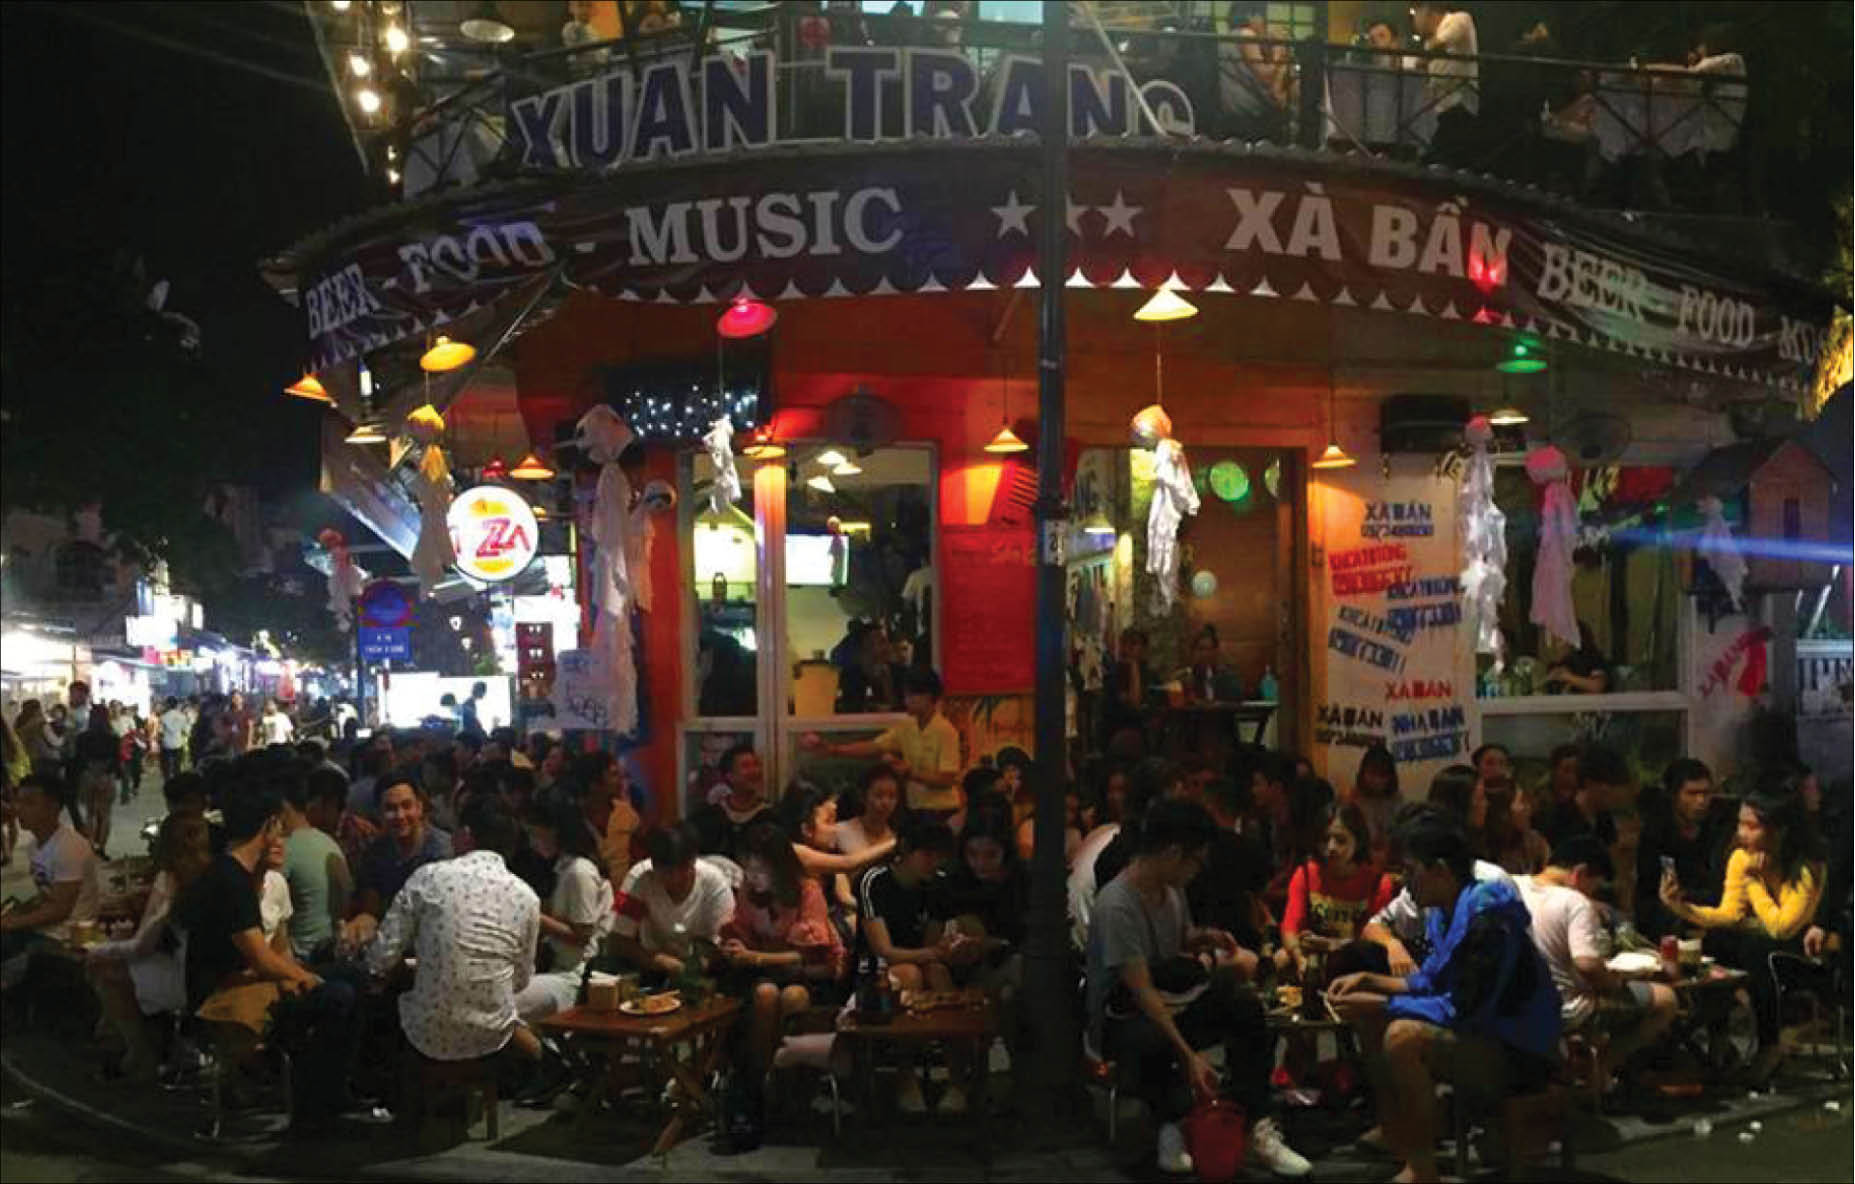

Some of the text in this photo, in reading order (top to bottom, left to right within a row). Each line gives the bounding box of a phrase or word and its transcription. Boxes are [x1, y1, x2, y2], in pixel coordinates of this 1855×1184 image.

[305, 262, 381, 340] BEER
[398, 221, 555, 293] FOOD
[626, 187, 904, 267] MUSIC
[1225, 181, 1343, 261] XÀ
[1536, 242, 1648, 322] BEER
[1679, 283, 1755, 349] FOOD
